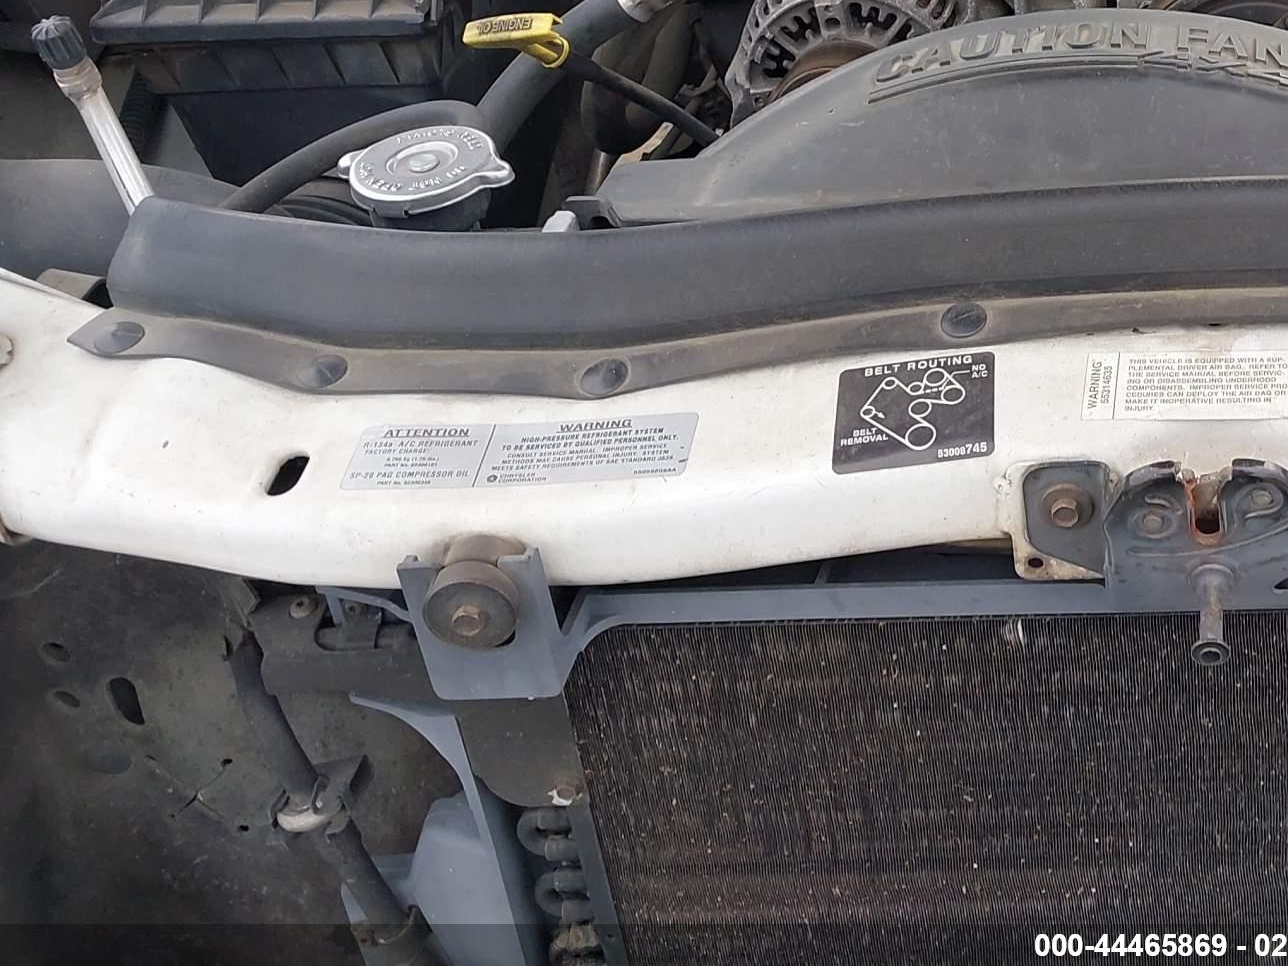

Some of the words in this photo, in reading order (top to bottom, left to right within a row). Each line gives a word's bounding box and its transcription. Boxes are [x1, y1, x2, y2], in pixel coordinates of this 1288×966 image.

[492, 18, 533, 32] ENGINE
[874, 23, 1152, 84] CAUTION
[865, 364, 900, 377] BELT
[907, 355, 973, 371] ROUTING
[1087, 361, 1102, 409] WARNING
[1101, 365, 1112, 404] 55314635
[559, 419, 632, 432] WARNING
[853, 427, 877, 437] BELT
[383, 428, 470, 437] ATTENTION
[521, 434, 579, 443] HIGH-PRESSURE
[582, 429, 632, 438] REFRIGERANT
[575, 438, 612, 447] QUALIFIED
[614, 436, 656, 444] PERSONNEL
[840, 434, 888, 446] REMOVAL
[542, 460, 593, 468] REQUIREMENTS
